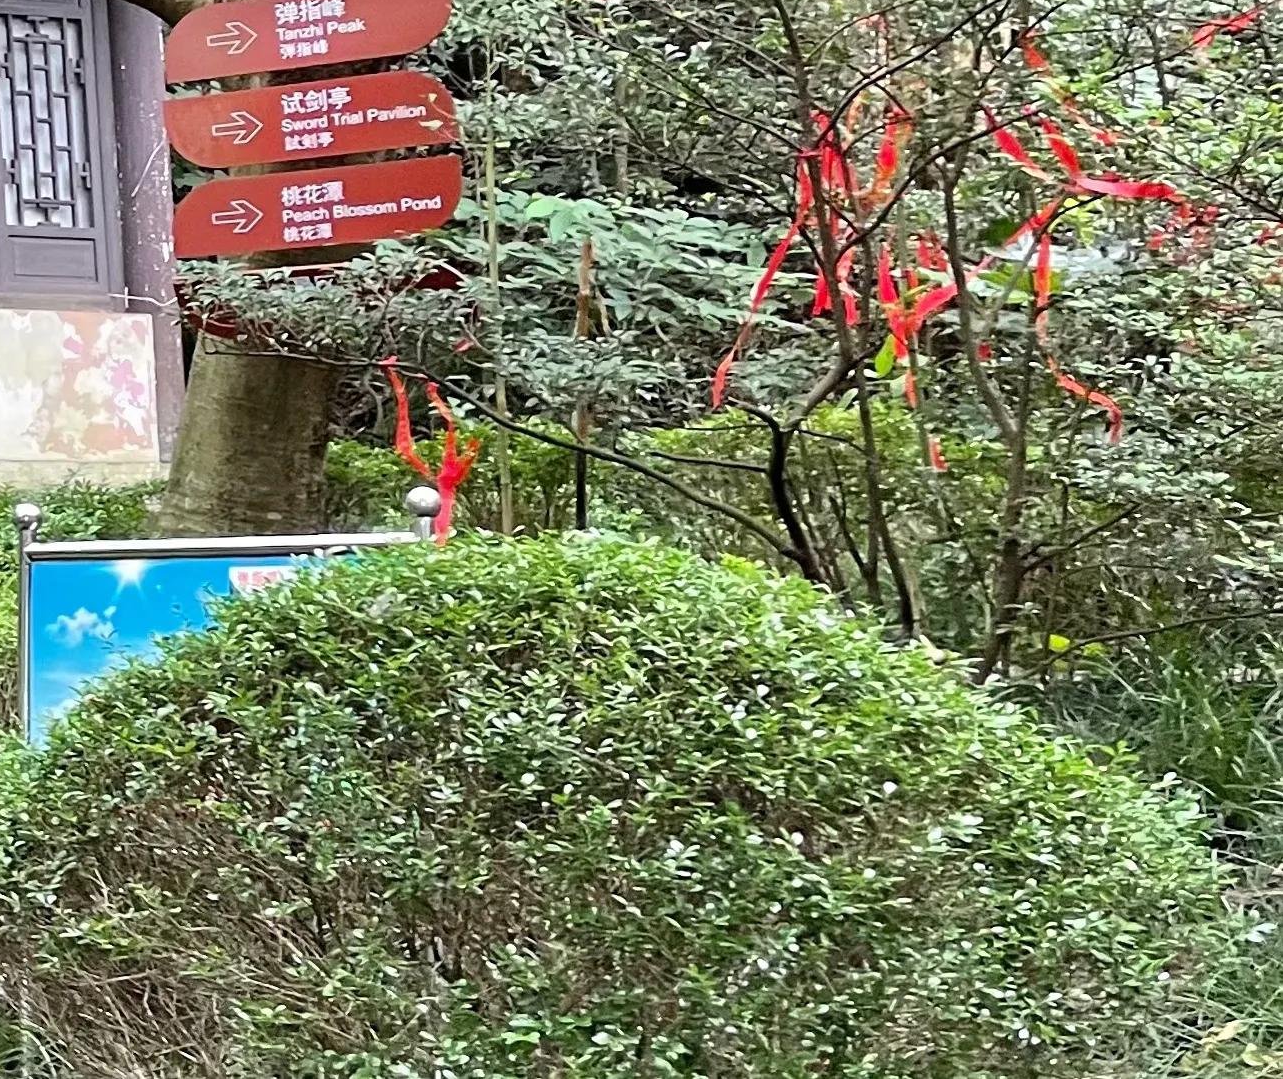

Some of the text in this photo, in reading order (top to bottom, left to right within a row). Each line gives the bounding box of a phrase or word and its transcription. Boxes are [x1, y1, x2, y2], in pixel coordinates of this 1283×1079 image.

[275, 18, 367, 41] Tanzhi Peak
[280, 86, 352, 114] 试剑亭
[281, 105, 427, 132] Sword Trial Pavilion
[282, 195, 442, 224] Peach Blossom Pond
